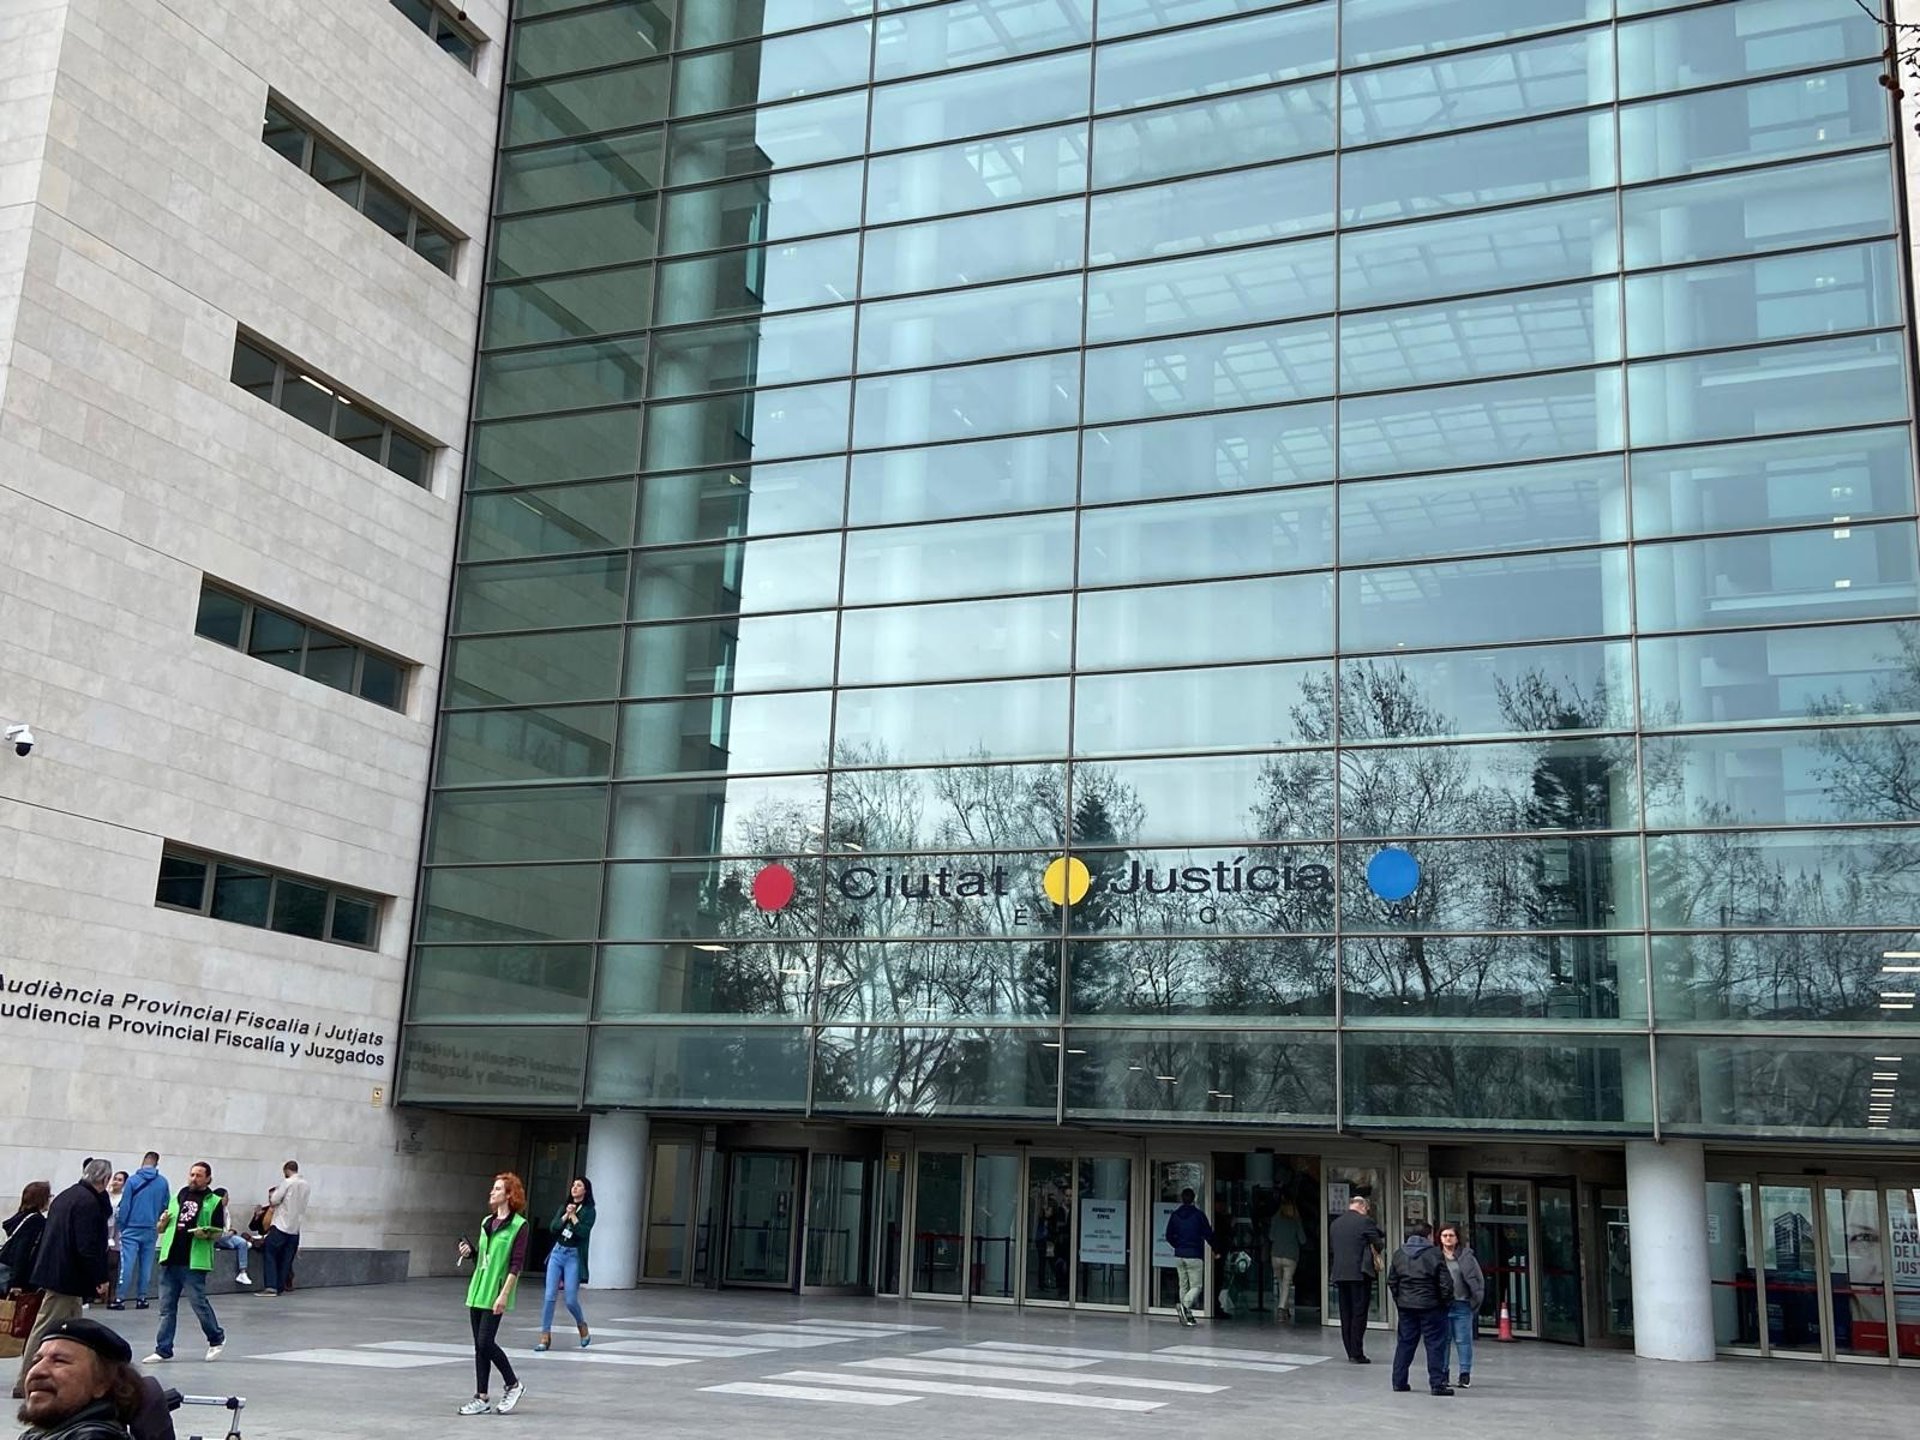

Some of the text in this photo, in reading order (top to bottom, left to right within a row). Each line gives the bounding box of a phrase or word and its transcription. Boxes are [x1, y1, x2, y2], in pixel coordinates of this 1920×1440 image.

[838, 855, 1335, 899] Ciutat Justícia
[108, 1014, 210, 1043] Provincial
[215, 1029, 285, 1052] Fiscalía
[289, 1042, 300, 1058] y
[304, 1042, 385, 1066] Juzgados
[121, 993, 231, 1023] Provincial
[235, 1010, 309, 1035] Fiscalia
[315, 1022, 321, 1036] i
[325, 1024, 384, 1046] Jutjats
[1894, 1245, 1910, 1258] DE
